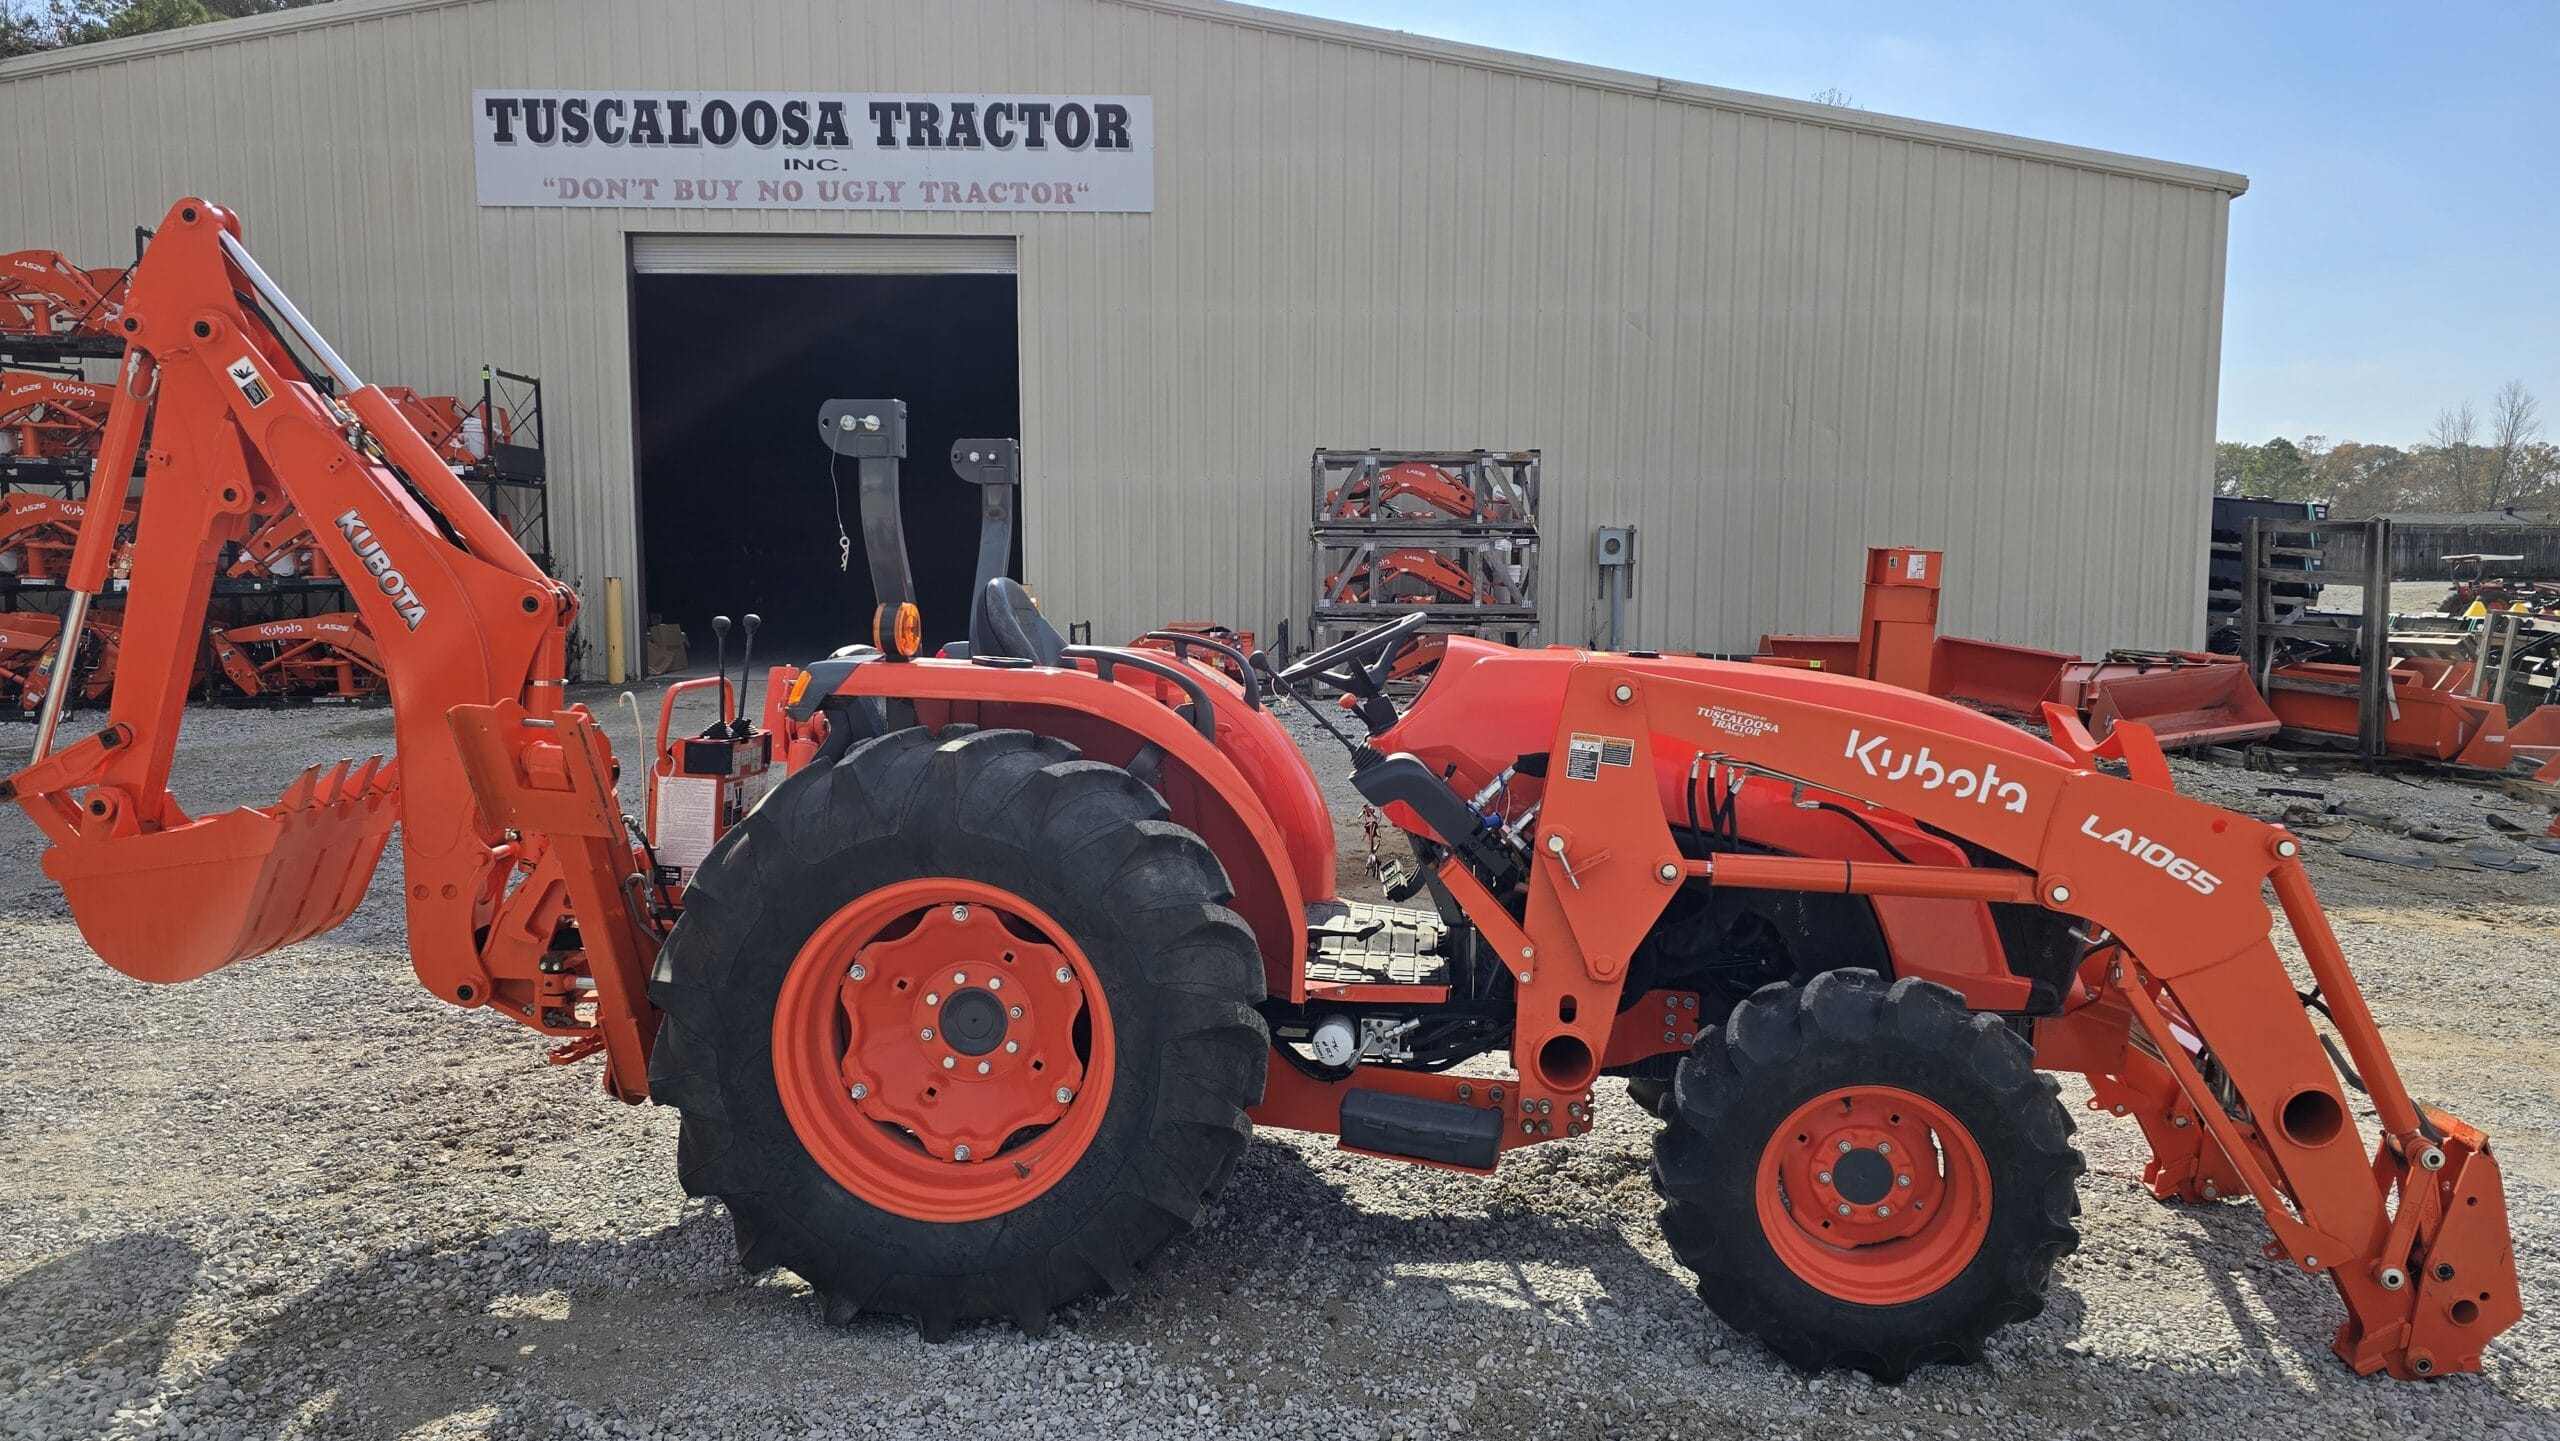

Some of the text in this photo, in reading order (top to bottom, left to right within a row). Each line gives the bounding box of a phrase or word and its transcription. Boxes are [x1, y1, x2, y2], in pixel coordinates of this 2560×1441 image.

[485, 98, 1132, 150] TUSCALOOSA TRACTOR
[784, 158, 847, 171] INC.
[673, 179, 743, 201] BUY
[757, 179, 803, 202] NO
[817, 180, 905, 202] UGLY
[14, 259, 48, 273] LA526
[11, 382, 96, 398] LA526 Kubota
[16, 502, 85, 516] LA526 Kub
[333, 507, 427, 633] KUBOTA
[261, 623, 350, 636] Kubota LA526
[1697, 707, 1779, 733] TUSCALOOSA
[1712, 719, 1761, 736] TRACTOR
[1844, 728, 2028, 814] Kubota
[2080, 814, 2222, 896] LA1065
